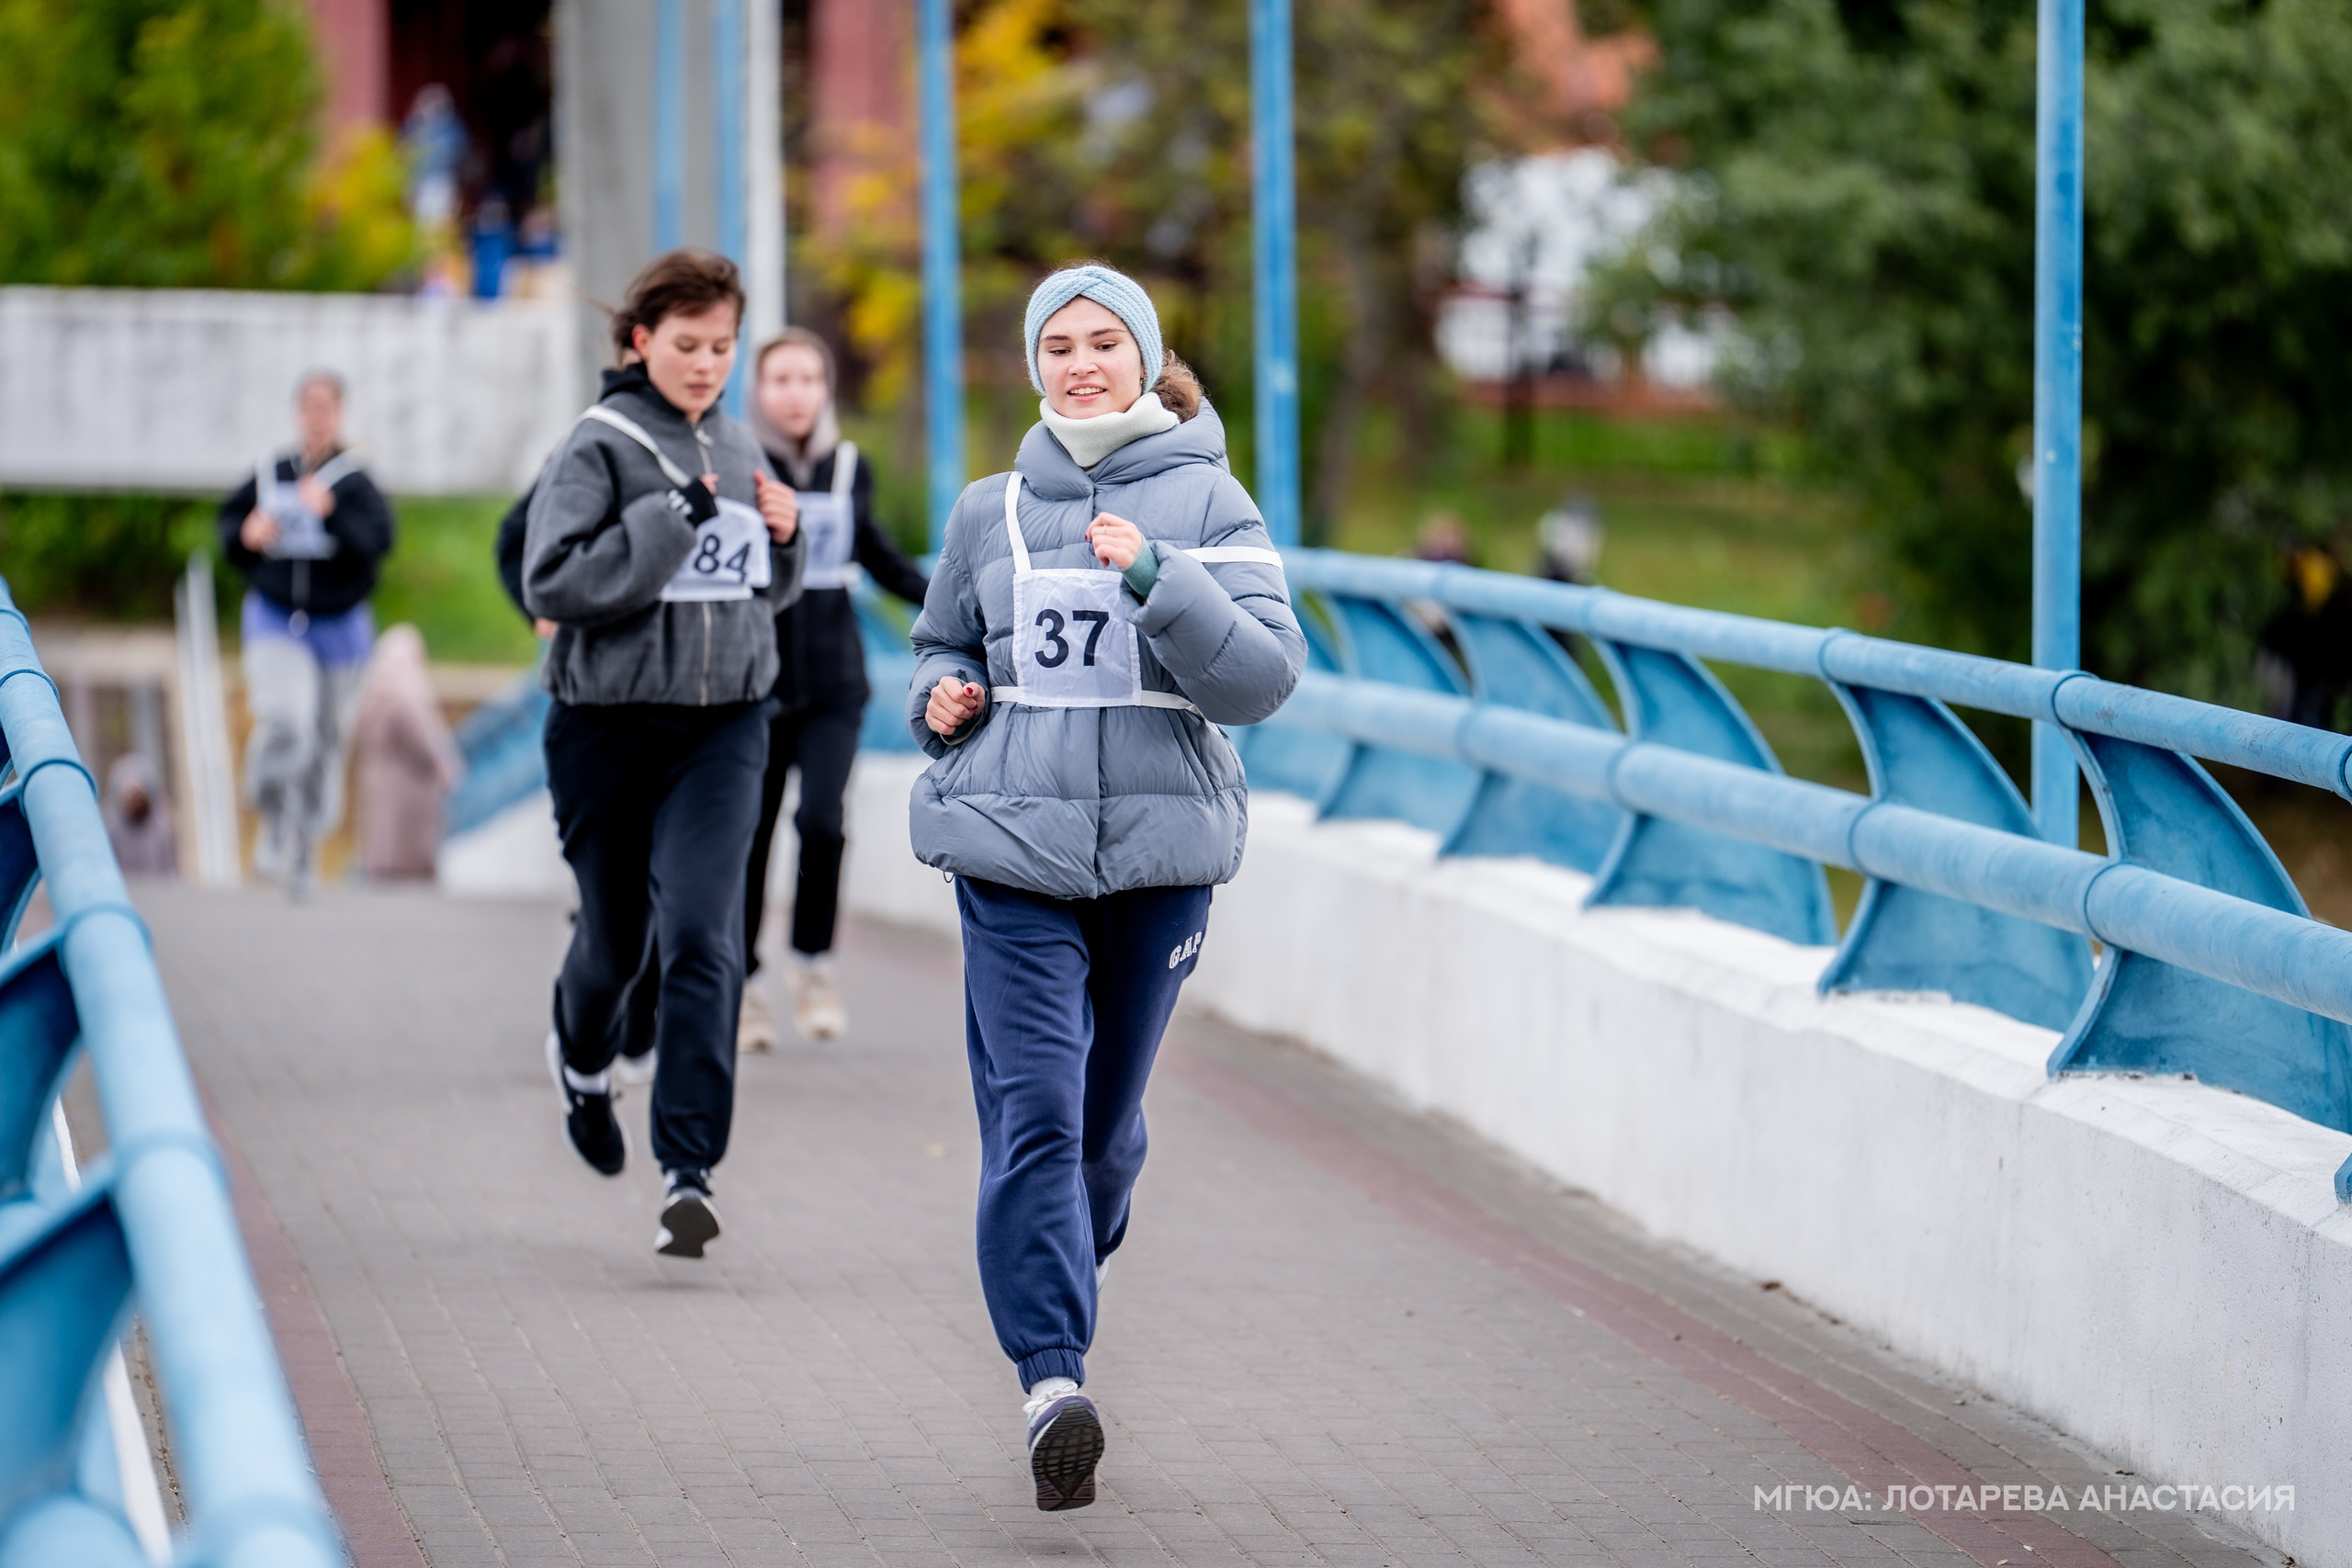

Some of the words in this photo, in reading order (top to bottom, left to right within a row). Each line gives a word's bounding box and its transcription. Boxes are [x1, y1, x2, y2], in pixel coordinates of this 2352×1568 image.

[694, 535, 750, 583] 84
[1035, 608, 1110, 669] 37
[1169, 931, 1202, 969] GAP
